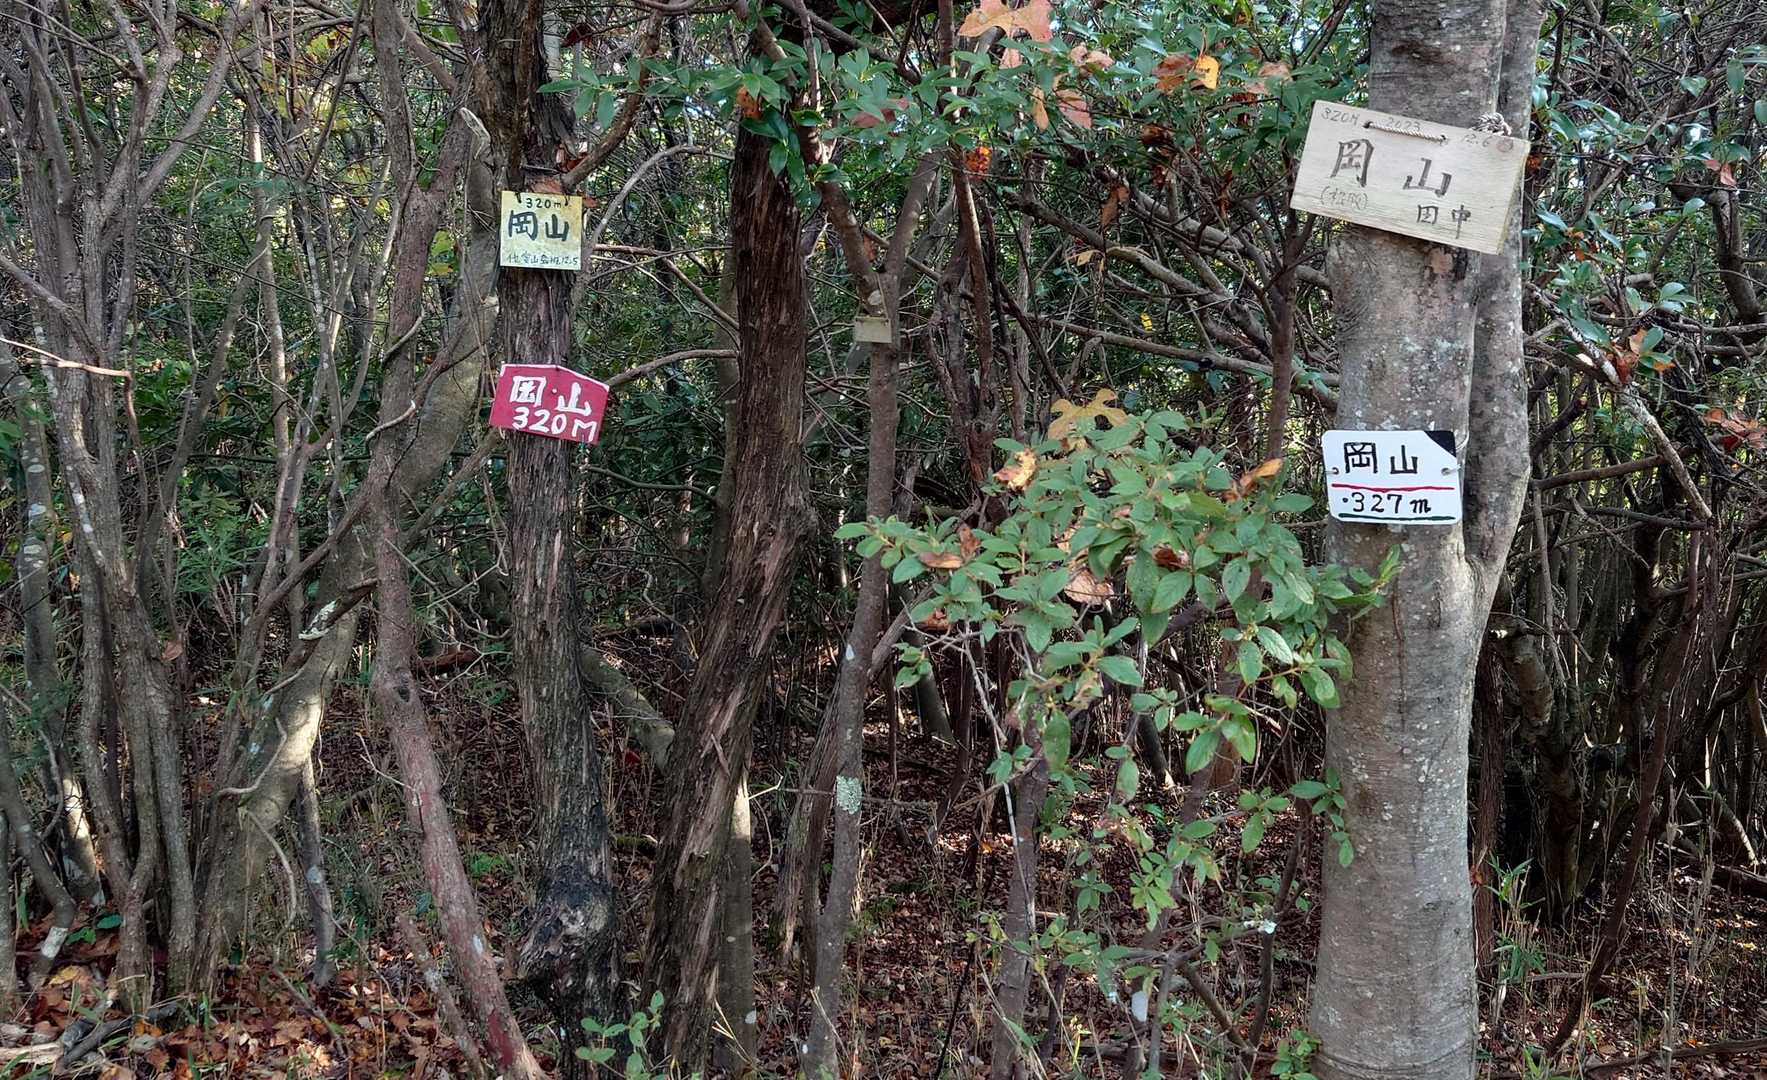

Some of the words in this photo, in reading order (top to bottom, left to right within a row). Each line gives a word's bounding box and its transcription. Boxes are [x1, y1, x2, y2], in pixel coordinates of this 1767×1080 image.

[526, 197, 562, 209] 320m
[508, 209, 570, 242] 岡山
[1416, 204, 1472, 240] 田中
[512, 406, 597, 442] 320M
[1344, 442, 1418, 475] 岡山
